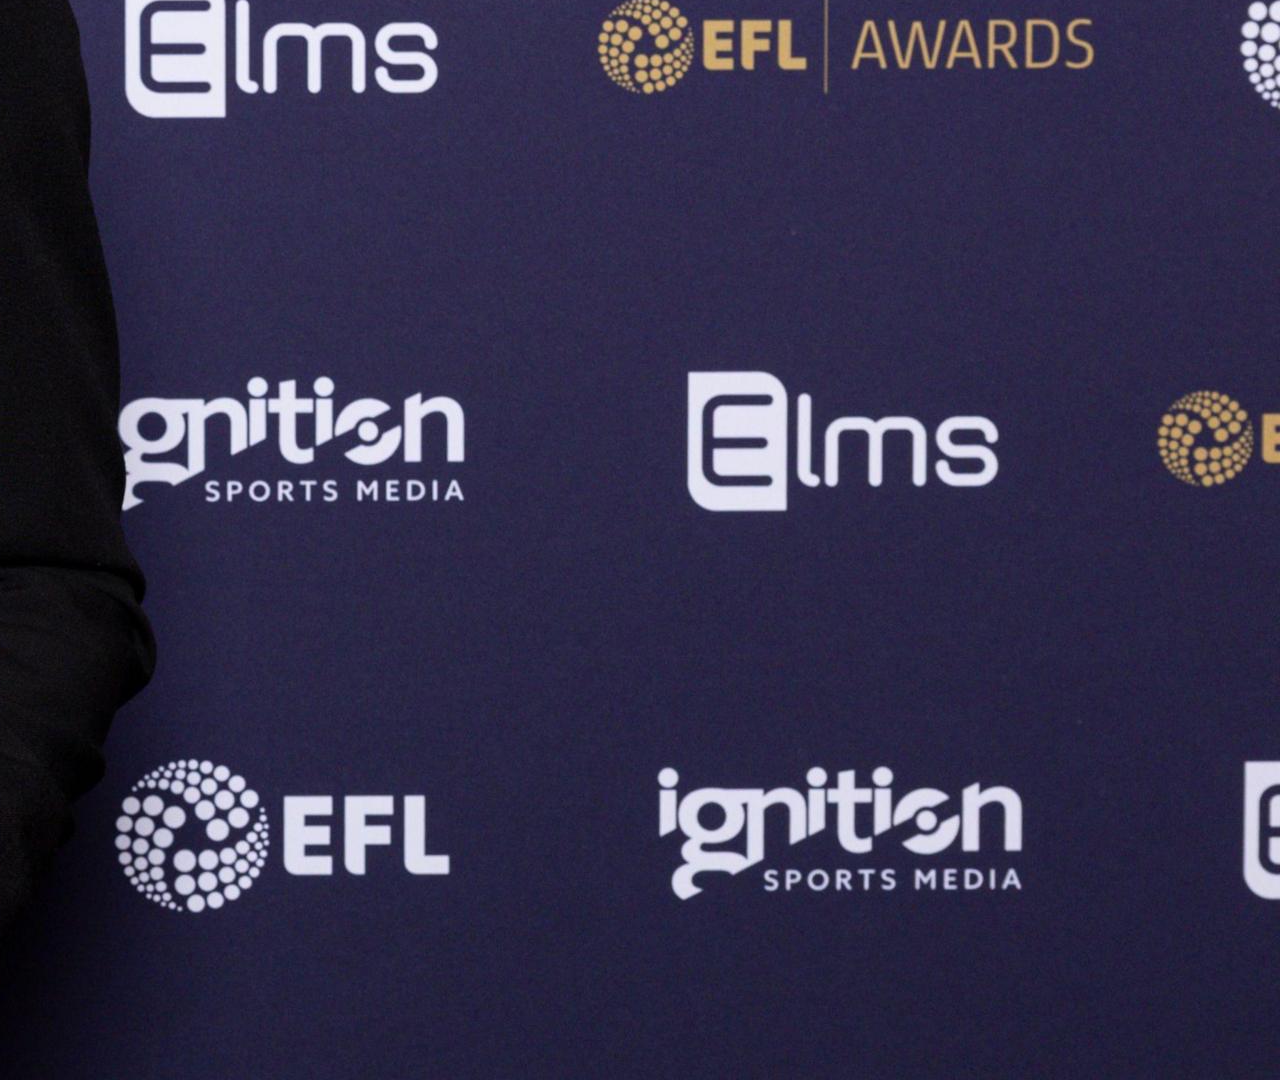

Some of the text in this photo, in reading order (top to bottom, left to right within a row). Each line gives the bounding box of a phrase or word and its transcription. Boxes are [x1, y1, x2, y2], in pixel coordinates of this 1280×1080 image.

[702, 18, 1094, 71] EFL AWARDS
[687, 371, 999, 512] Elms
[205, 479, 464, 502] SPORTS MEDIA
[283, 795, 450, 875] EFL
[658, 766, 1022, 900] ignition
[764, 869, 1022, 891] SPORTS MEDIA
